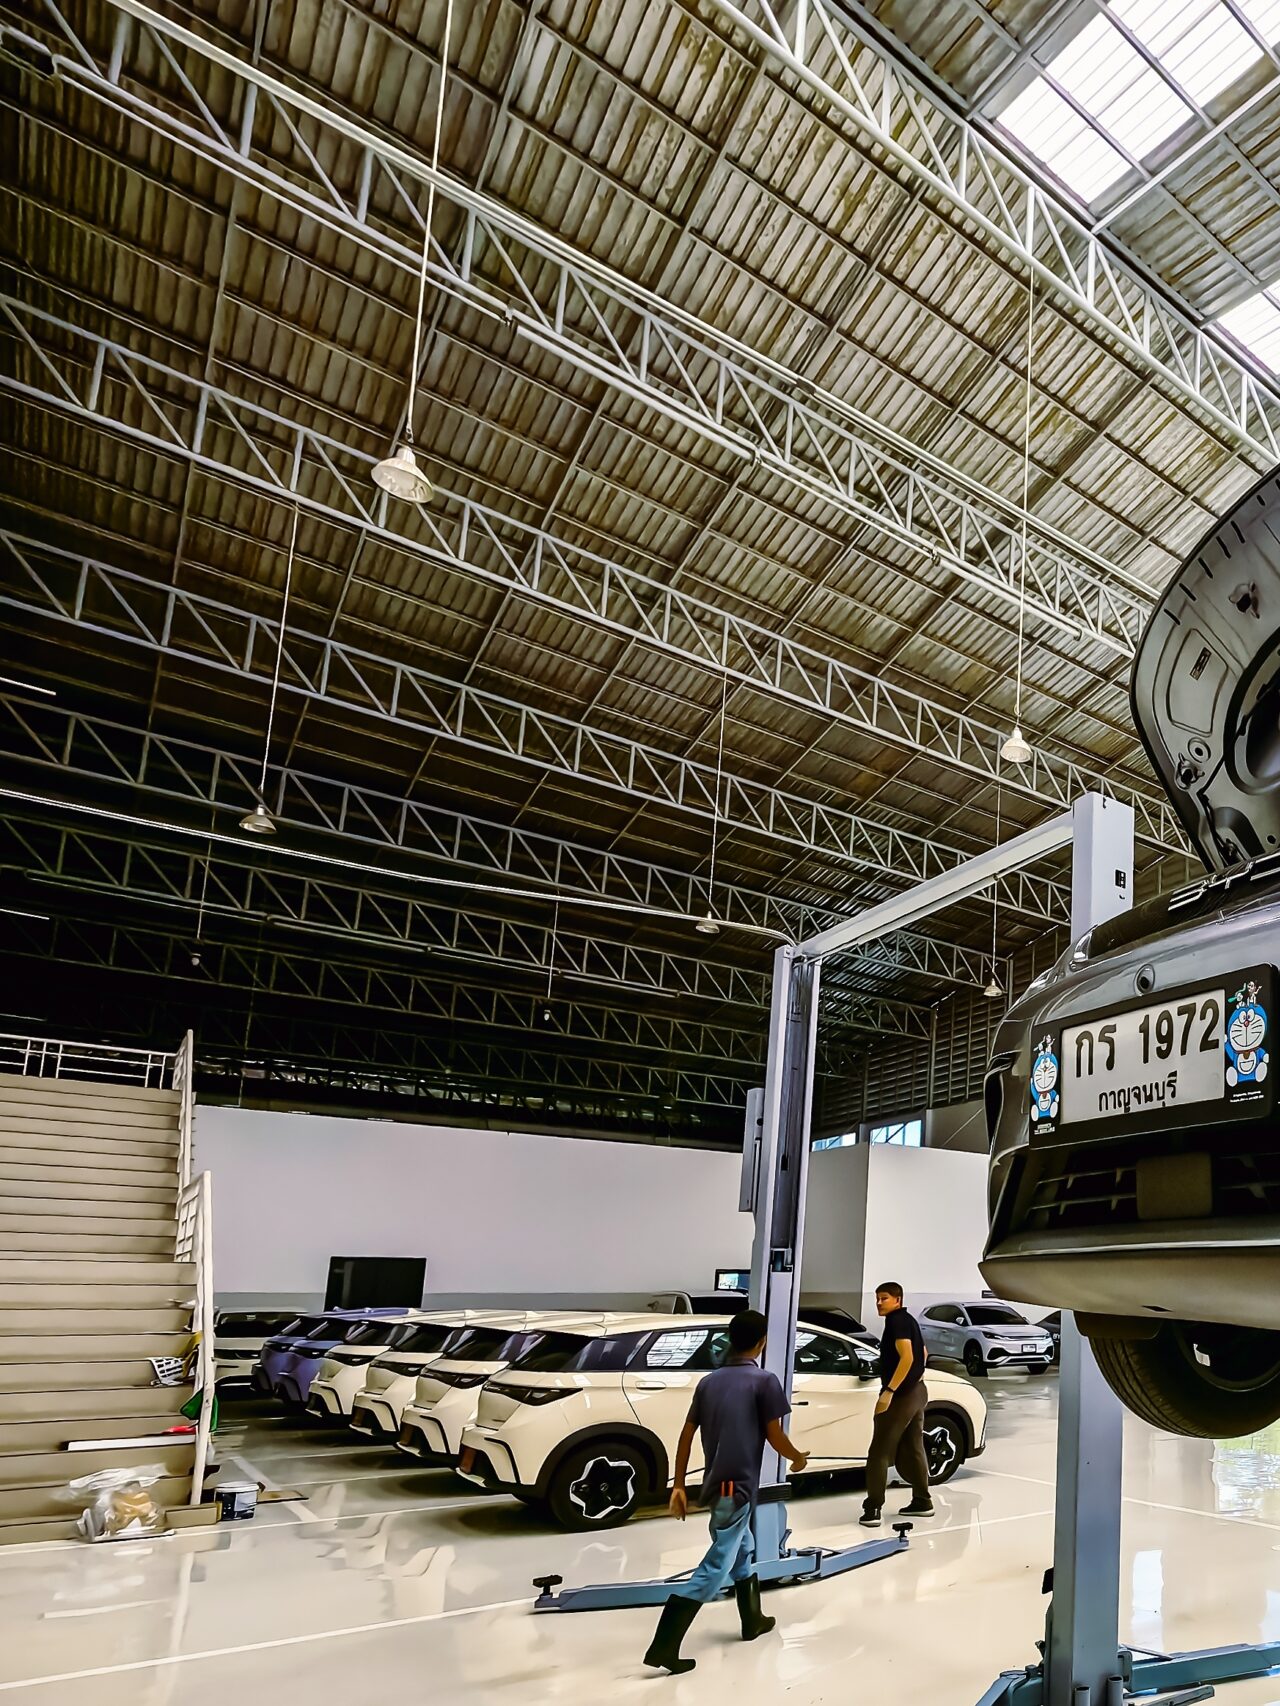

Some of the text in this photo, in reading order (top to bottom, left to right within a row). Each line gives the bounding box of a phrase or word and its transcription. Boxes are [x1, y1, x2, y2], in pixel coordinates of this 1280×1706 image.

[1075, 998, 1220, 1078] กร 1972
[1098, 1070, 1178, 1113] กาญจนบุรี
